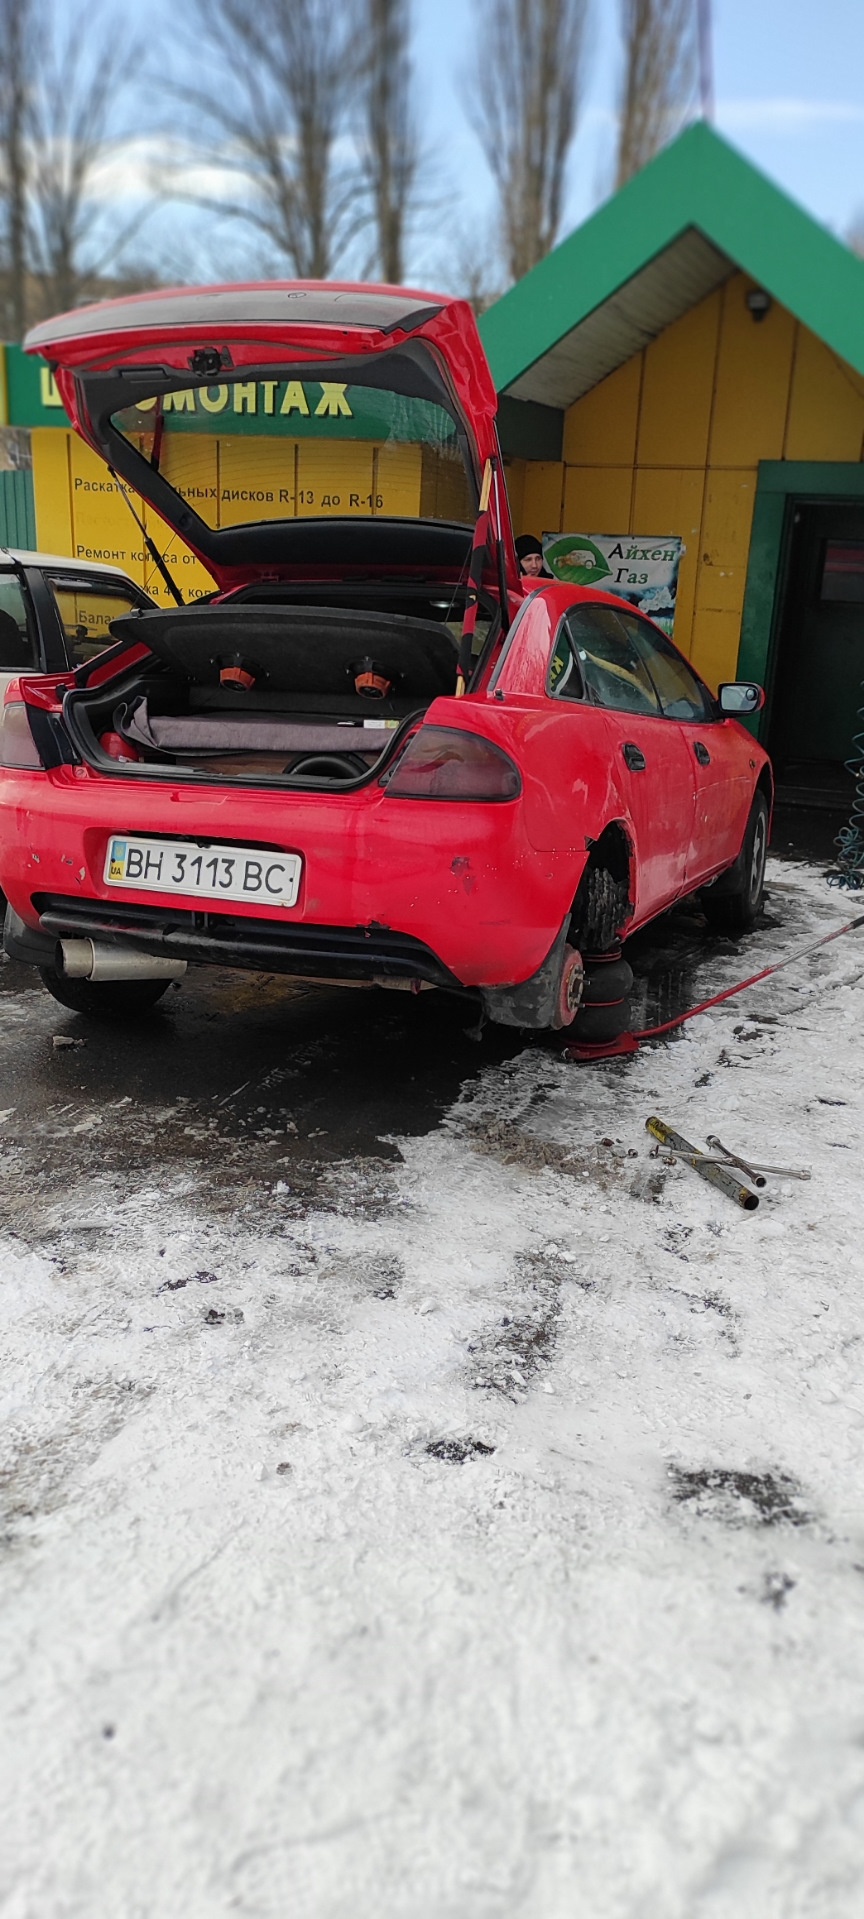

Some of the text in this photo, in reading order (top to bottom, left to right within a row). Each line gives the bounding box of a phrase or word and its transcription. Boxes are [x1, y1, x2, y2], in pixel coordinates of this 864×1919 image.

[221, 489, 274, 502] дисков
[279, 489, 314, 504] R-13
[321, 494, 341, 507] до
[349, 494, 384, 509] R-16
[77, 545, 197, 565] Ремонт колса от
[608, 543, 677, 561] Айхен
[614, 567, 648, 584] Газ
[79, 610, 115, 625] Бала
[110, 866, 122, 876] UA
[126, 848, 286, 894] BH 3113 BC
